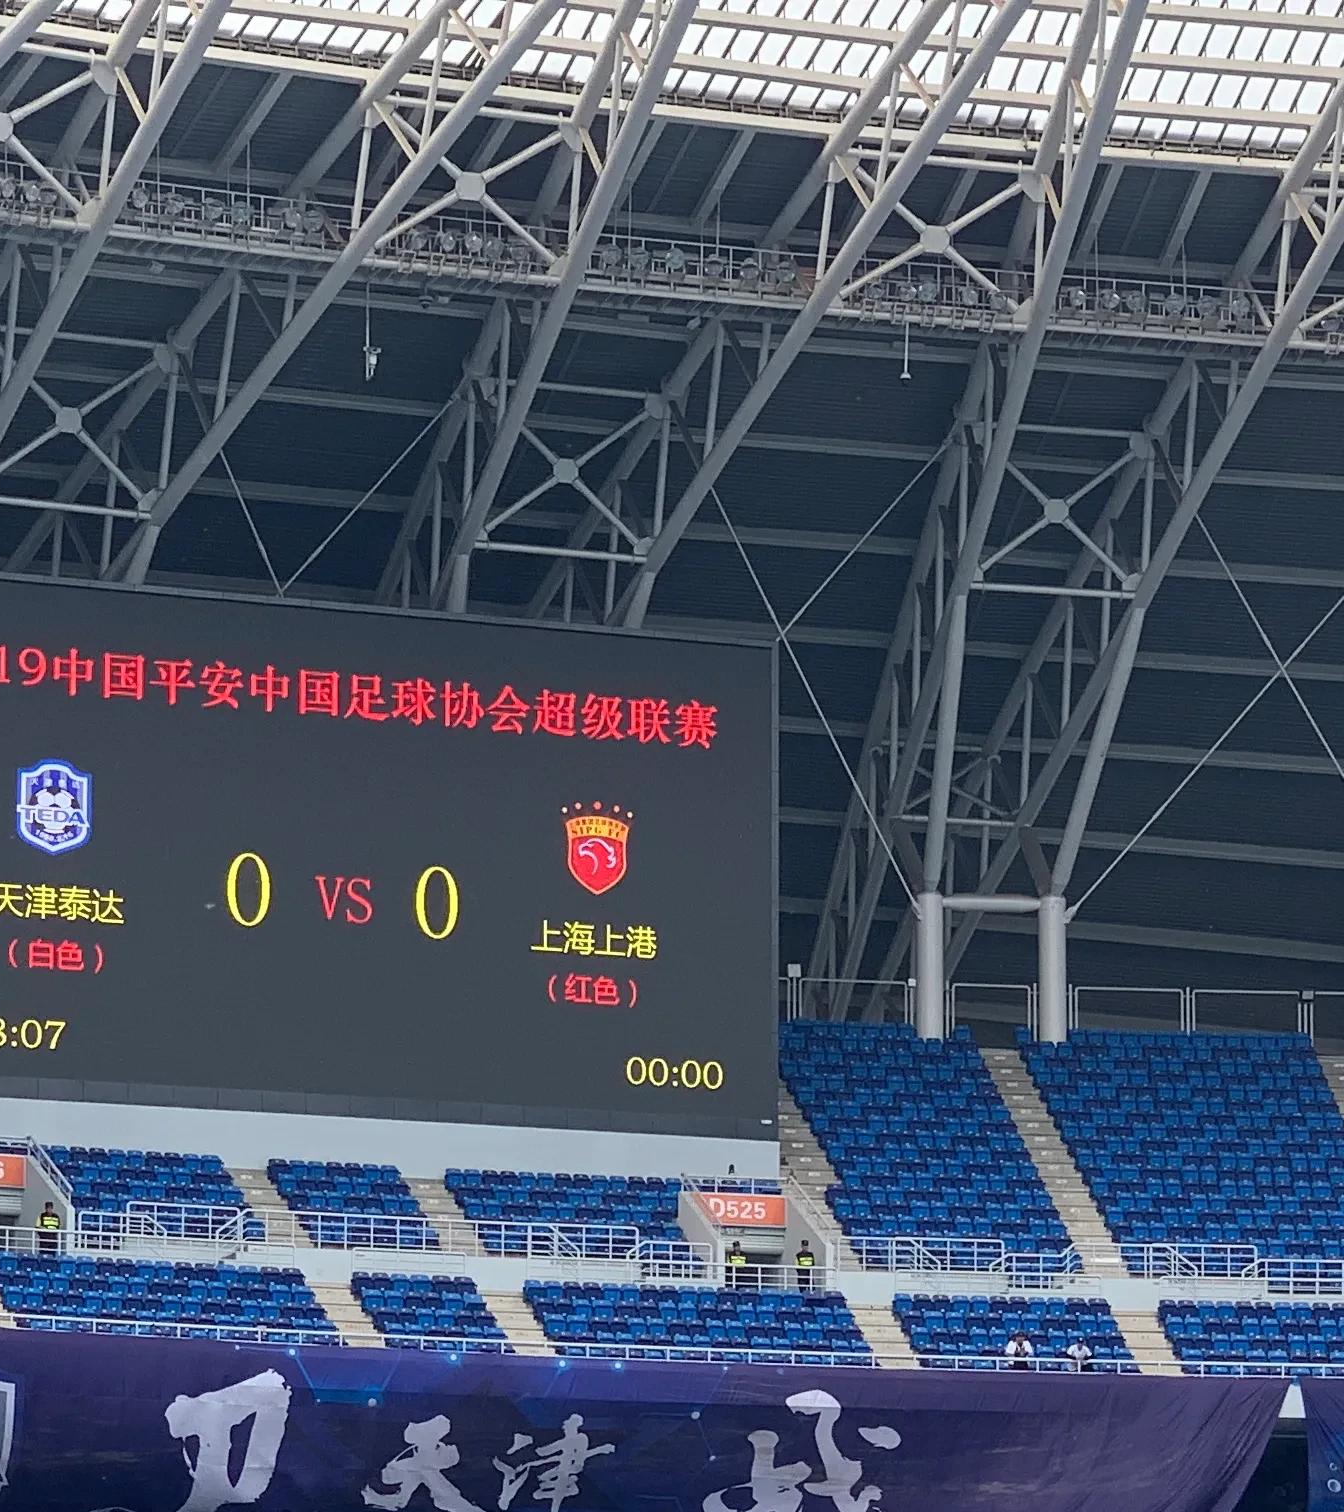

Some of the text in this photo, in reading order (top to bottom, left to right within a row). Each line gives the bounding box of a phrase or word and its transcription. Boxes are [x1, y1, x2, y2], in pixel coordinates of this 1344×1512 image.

[225, 852, 271, 928] 0
[314, 876, 374, 925] VS
[414, 865, 460, 940] 0
[531, 920, 658, 961] 上海上港
[626, 1057, 724, 1090] 00:00
[709, 1198, 767, 1220] D525
